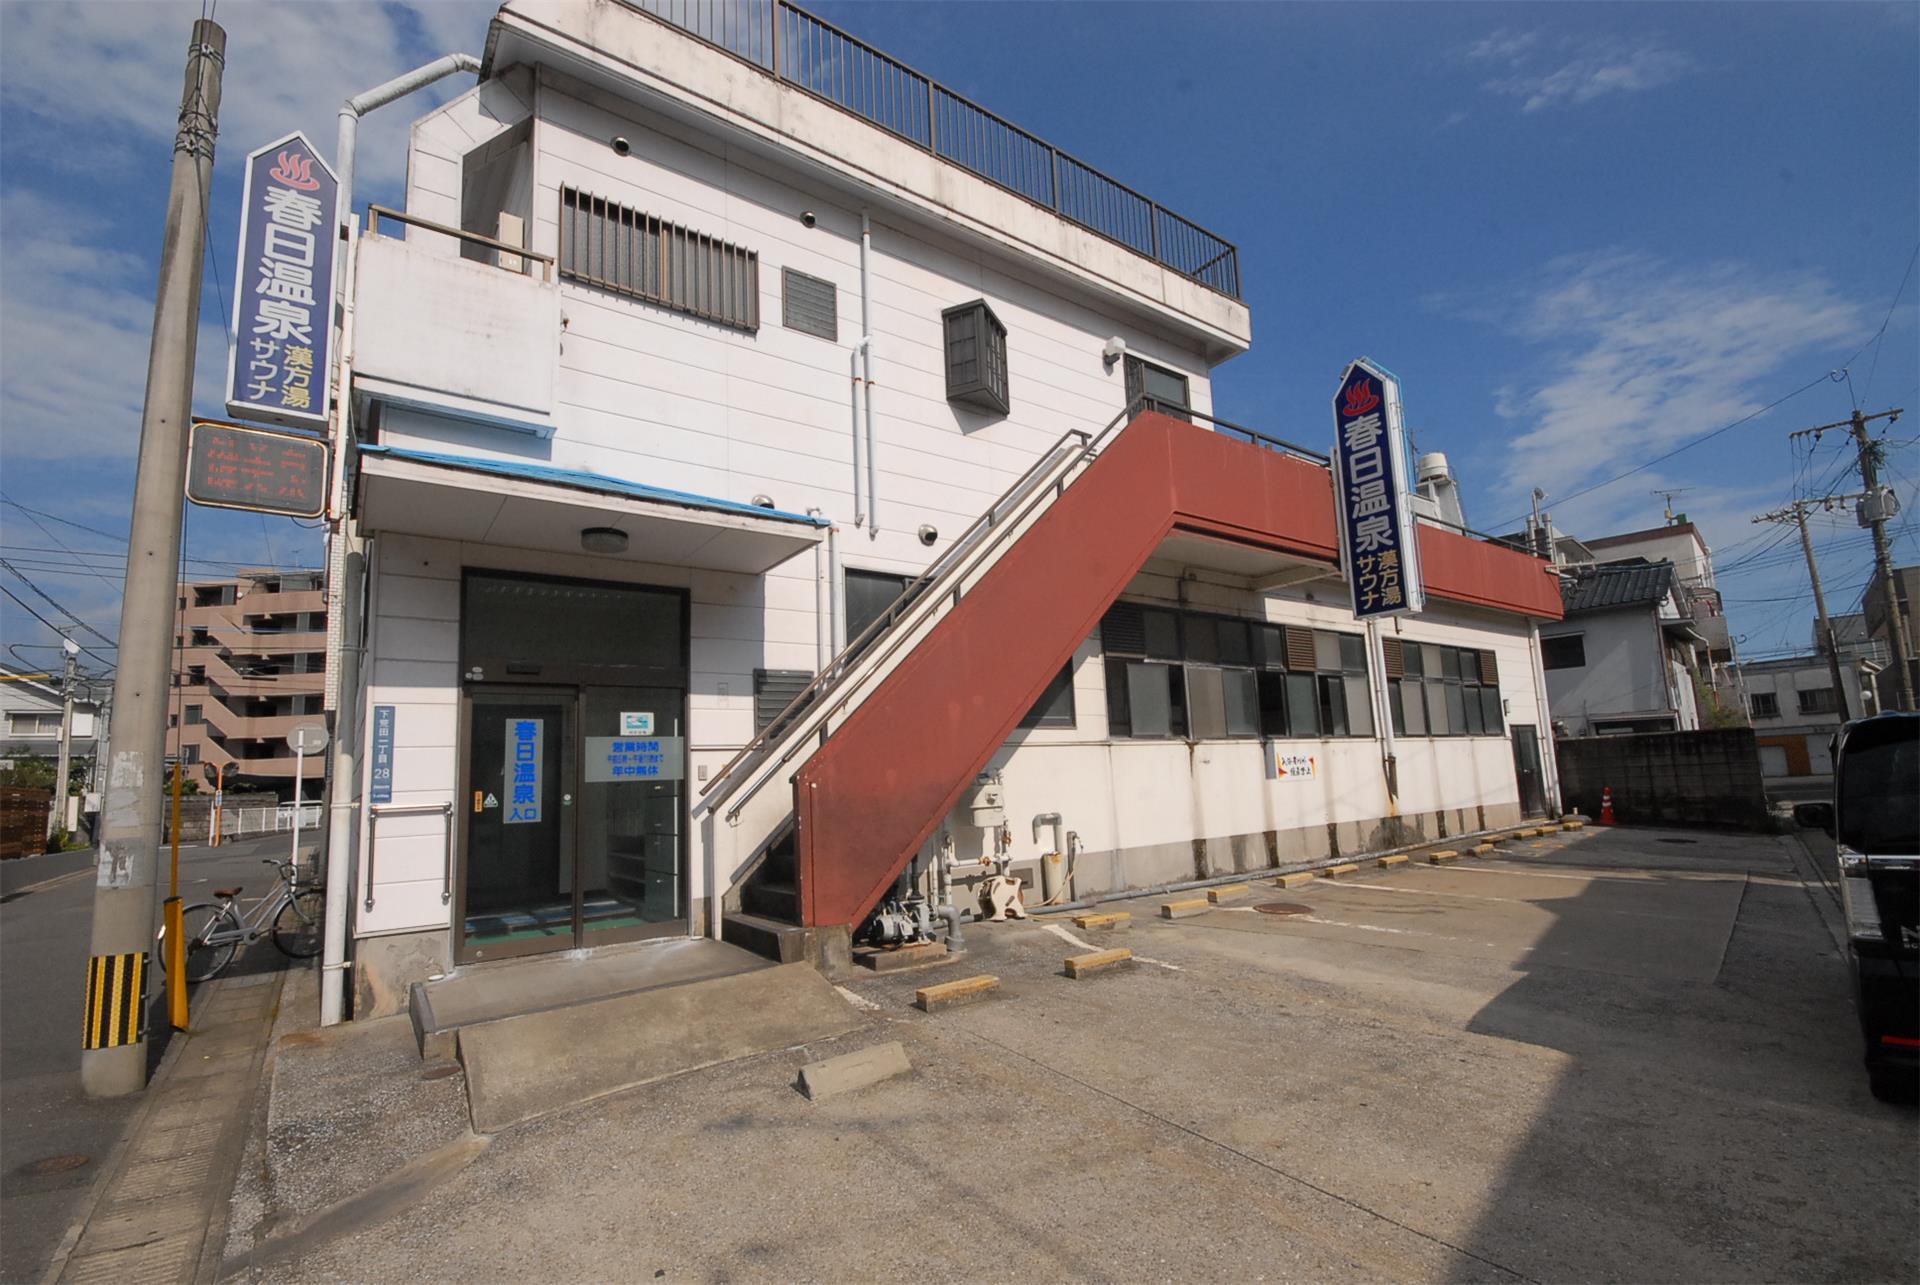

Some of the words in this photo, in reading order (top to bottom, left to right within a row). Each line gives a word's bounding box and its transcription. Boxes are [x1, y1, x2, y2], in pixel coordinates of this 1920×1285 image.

[252, 185, 322, 344] 春日温泉
[247, 338, 280, 401] サウナ
[280, 343, 313, 409] 漢方湯
[1344, 412, 1394, 553] 春日温泉
[1356, 555, 1380, 610] サウナ
[1377, 549, 1402, 606] 漢方湯
[374, 768, 390, 779] 28
[513, 720, 537, 805] 春日温泉
[612, 741, 659, 753] 営業時間
[612, 765, 659, 777] 年中無休
[509, 807, 537, 821] 入口
